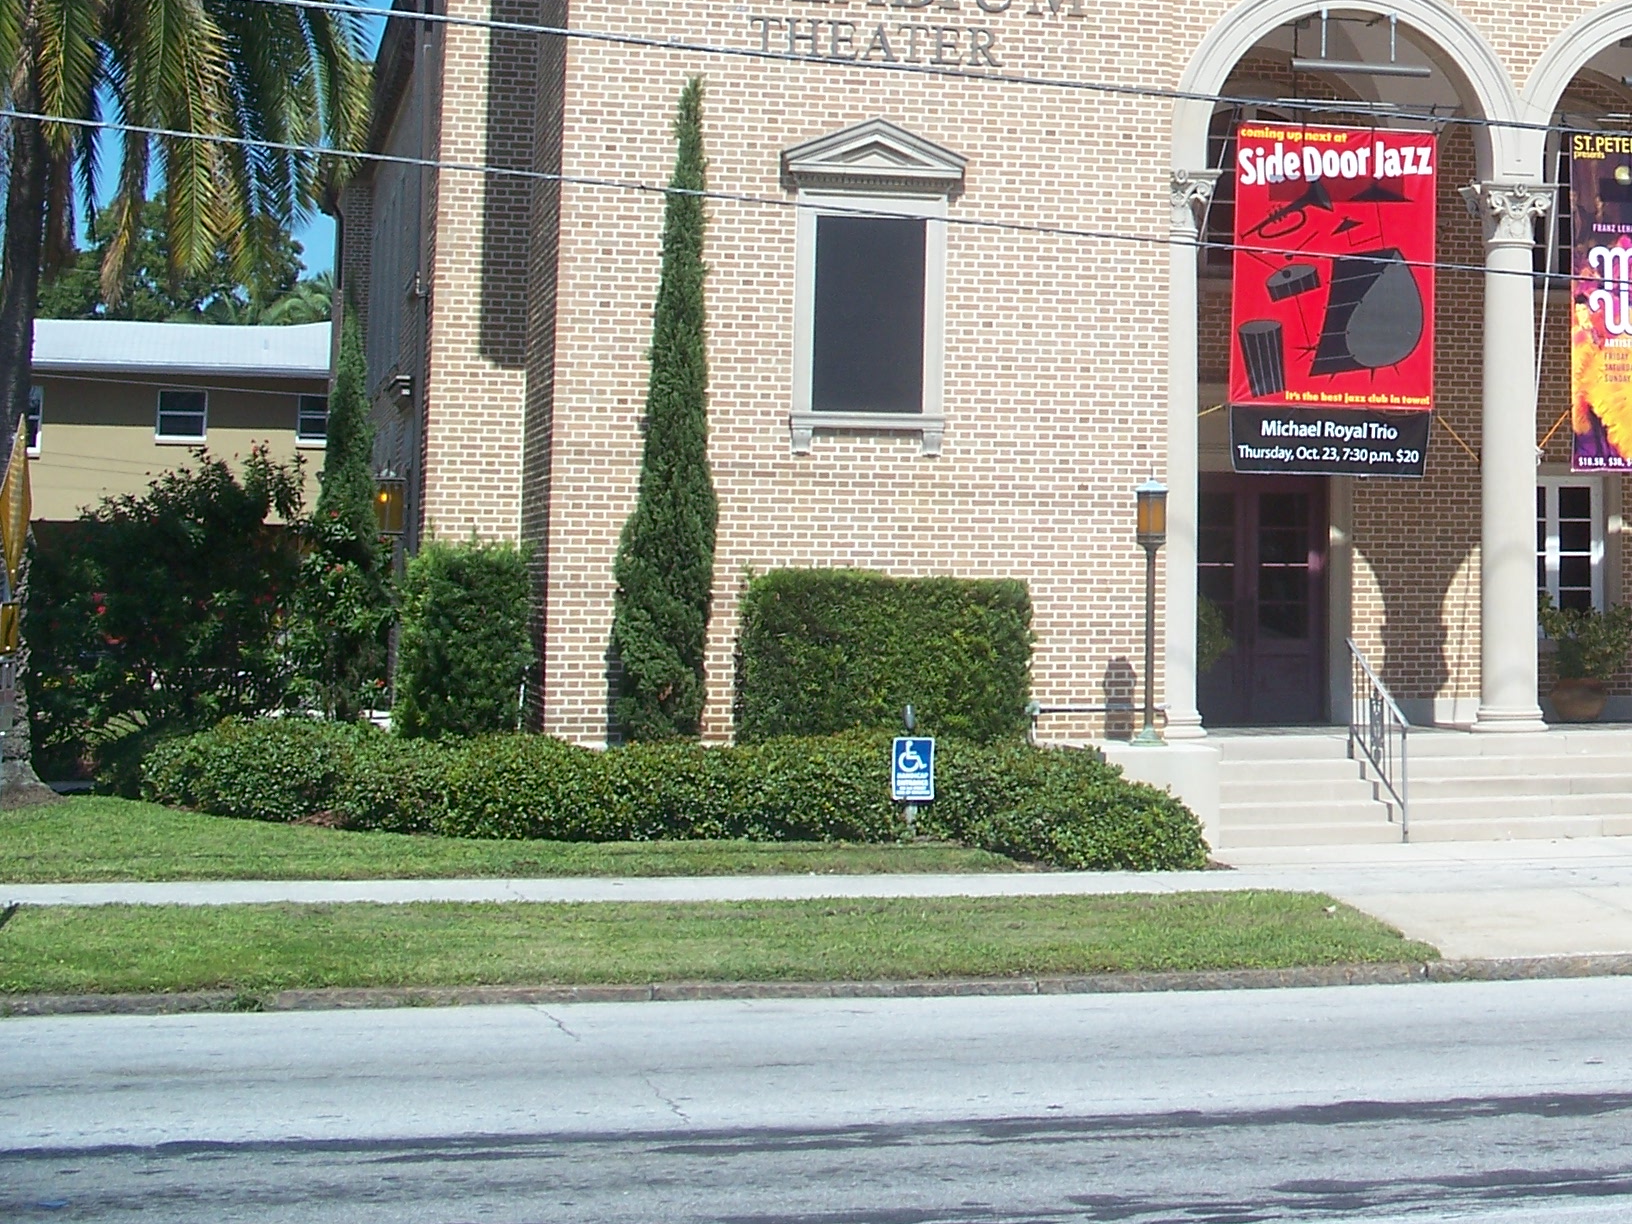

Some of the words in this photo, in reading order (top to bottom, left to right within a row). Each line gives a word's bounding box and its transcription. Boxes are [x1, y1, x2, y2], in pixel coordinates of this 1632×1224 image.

[750, 15, 1003, 68] THEATER
[1241, 127, 1284, 140] coming
[1286, 131, 1303, 143] up
[1304, 131, 1332, 143] next
[1333, 133, 1348, 143] at
[1238, 142, 1301, 185] Side
[1302, 145, 1372, 182] Door
[1373, 141, 1434, 180] Jazz
[1573, 151, 1606, 160] presents
[1592, 223, 1616, 233] FRANZ
[1604, 352, 1629, 361] FRIDAY
[1302, 391, 1319, 401] the
[1320, 392, 1343, 402] best
[1344, 392, 1367, 404] jazz
[1368, 393, 1389, 403] club
[1390, 394, 1400, 404] in
[1401, 395, 1431, 406] town!
[1261, 419, 1322, 437] Michael
[1324, 422, 1367, 443] Royal
[1369, 423, 1398, 440] Trio
[1237, 444, 1295, 463] Thursday,
[1296, 446, 1320, 461] Oct.
[1322, 447, 1340, 462] 23,
[1342, 447, 1368, 462] 7:30
[1369, 449, 1394, 465] p.m.
[1396, 448, 1420, 464] $20
